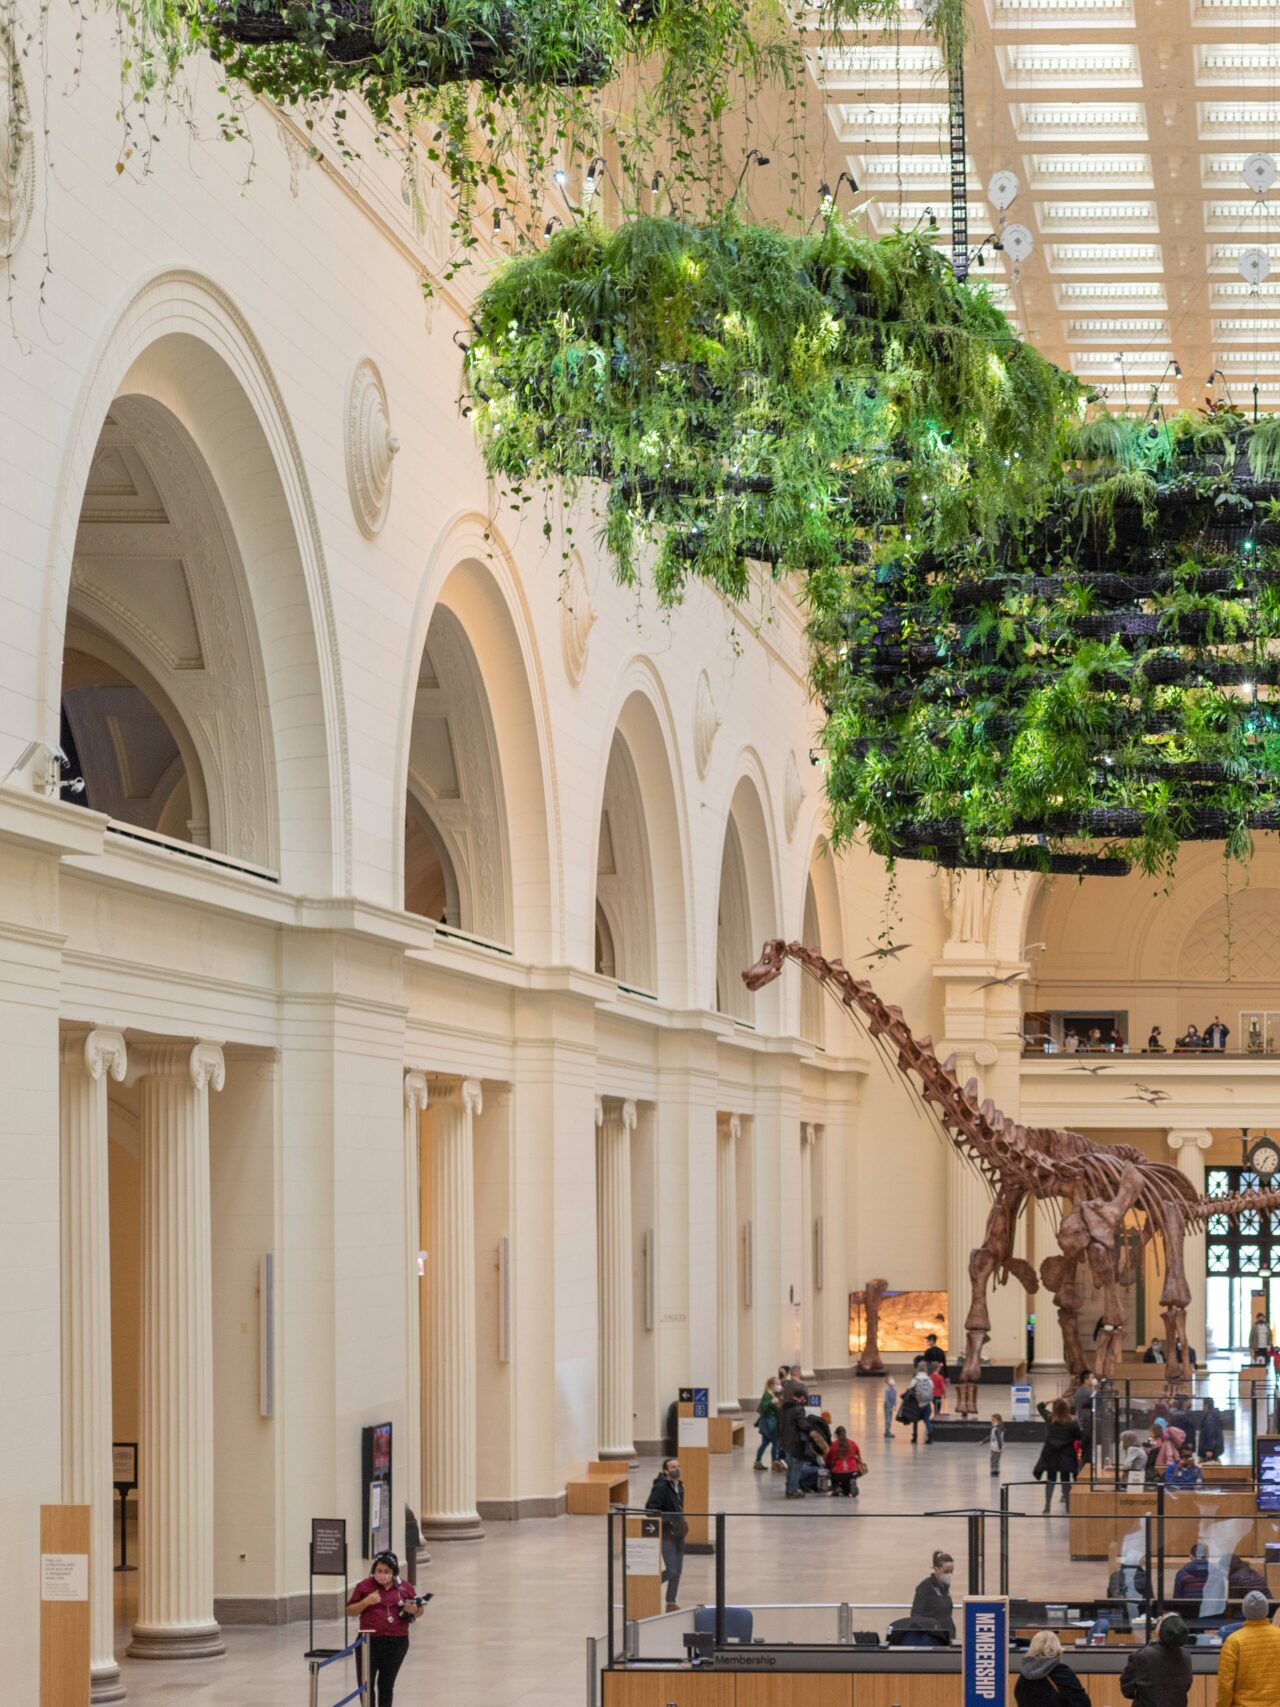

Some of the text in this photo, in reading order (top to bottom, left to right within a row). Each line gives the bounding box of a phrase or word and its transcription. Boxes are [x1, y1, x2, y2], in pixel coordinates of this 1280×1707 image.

[1119, 1498, 1157, 1506] Informatio
[715, 1655, 776, 1666] Membership
[975, 1613, 996, 1699] MEMBERSHIP
